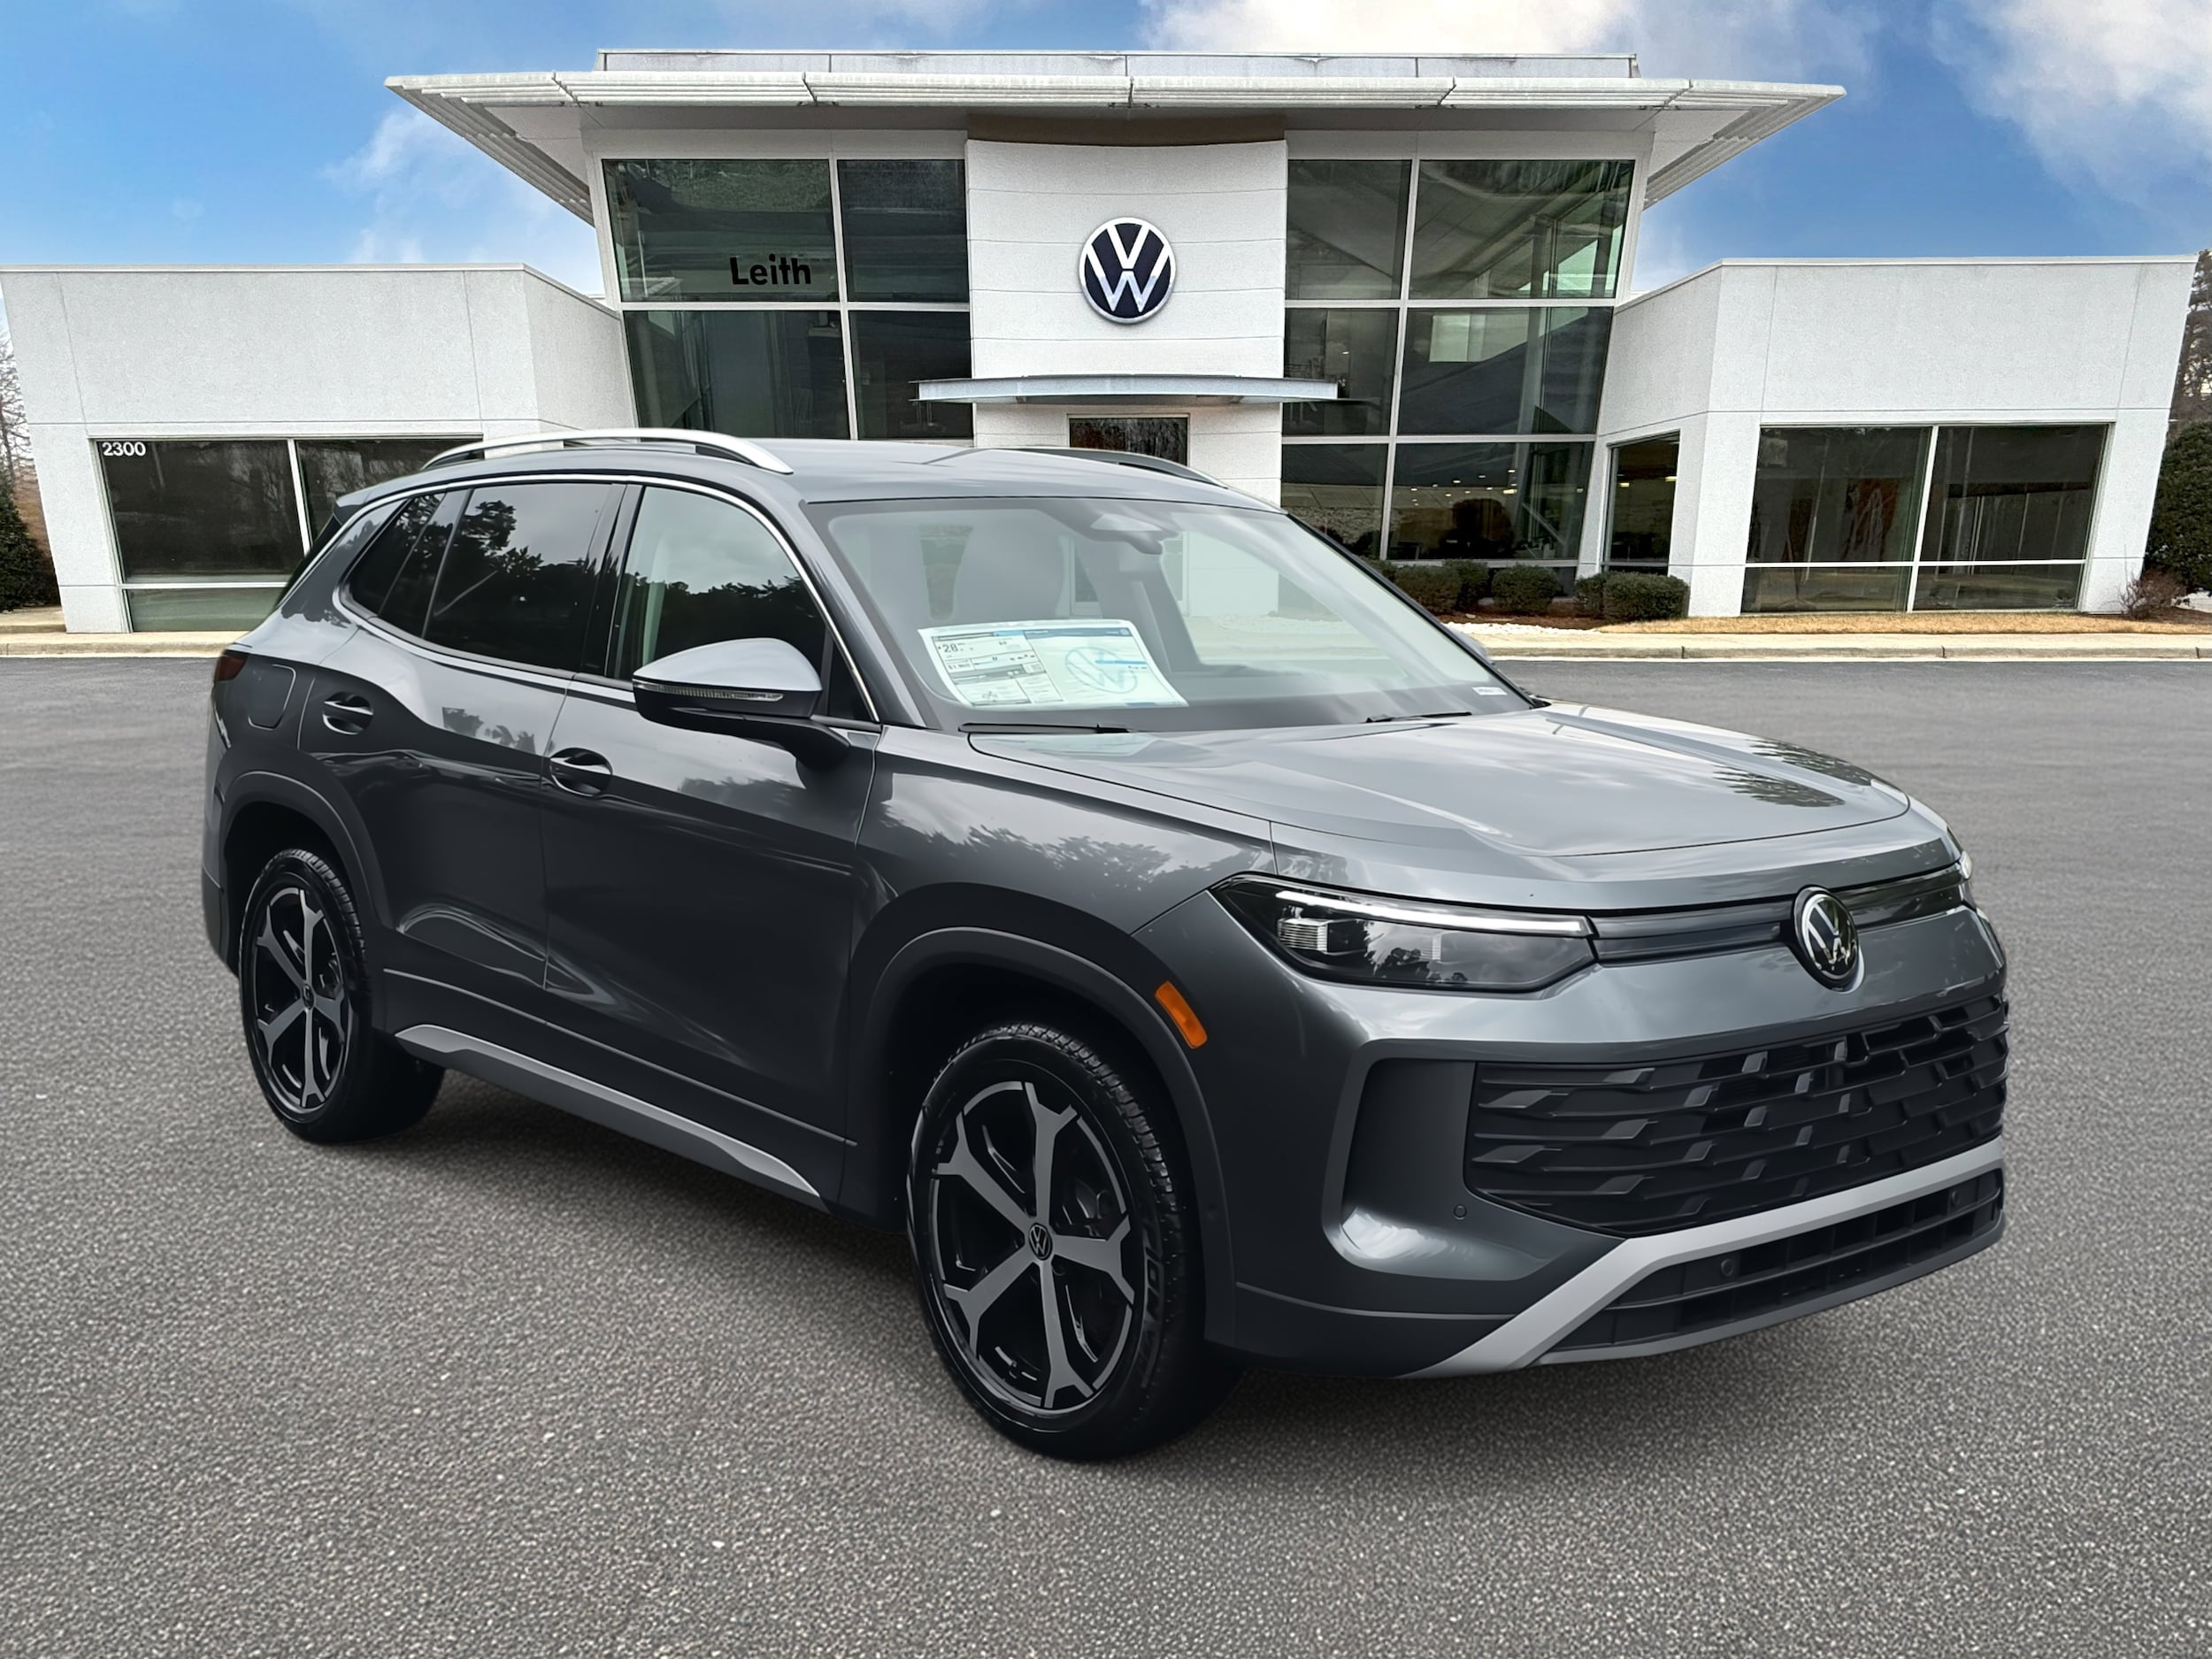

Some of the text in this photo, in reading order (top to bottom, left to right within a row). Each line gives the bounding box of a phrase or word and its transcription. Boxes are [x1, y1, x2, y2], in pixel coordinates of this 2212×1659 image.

[730, 253, 811, 285] Leith
[1081, 219, 1174, 319] VW
[102, 442, 146, 457] 2300
